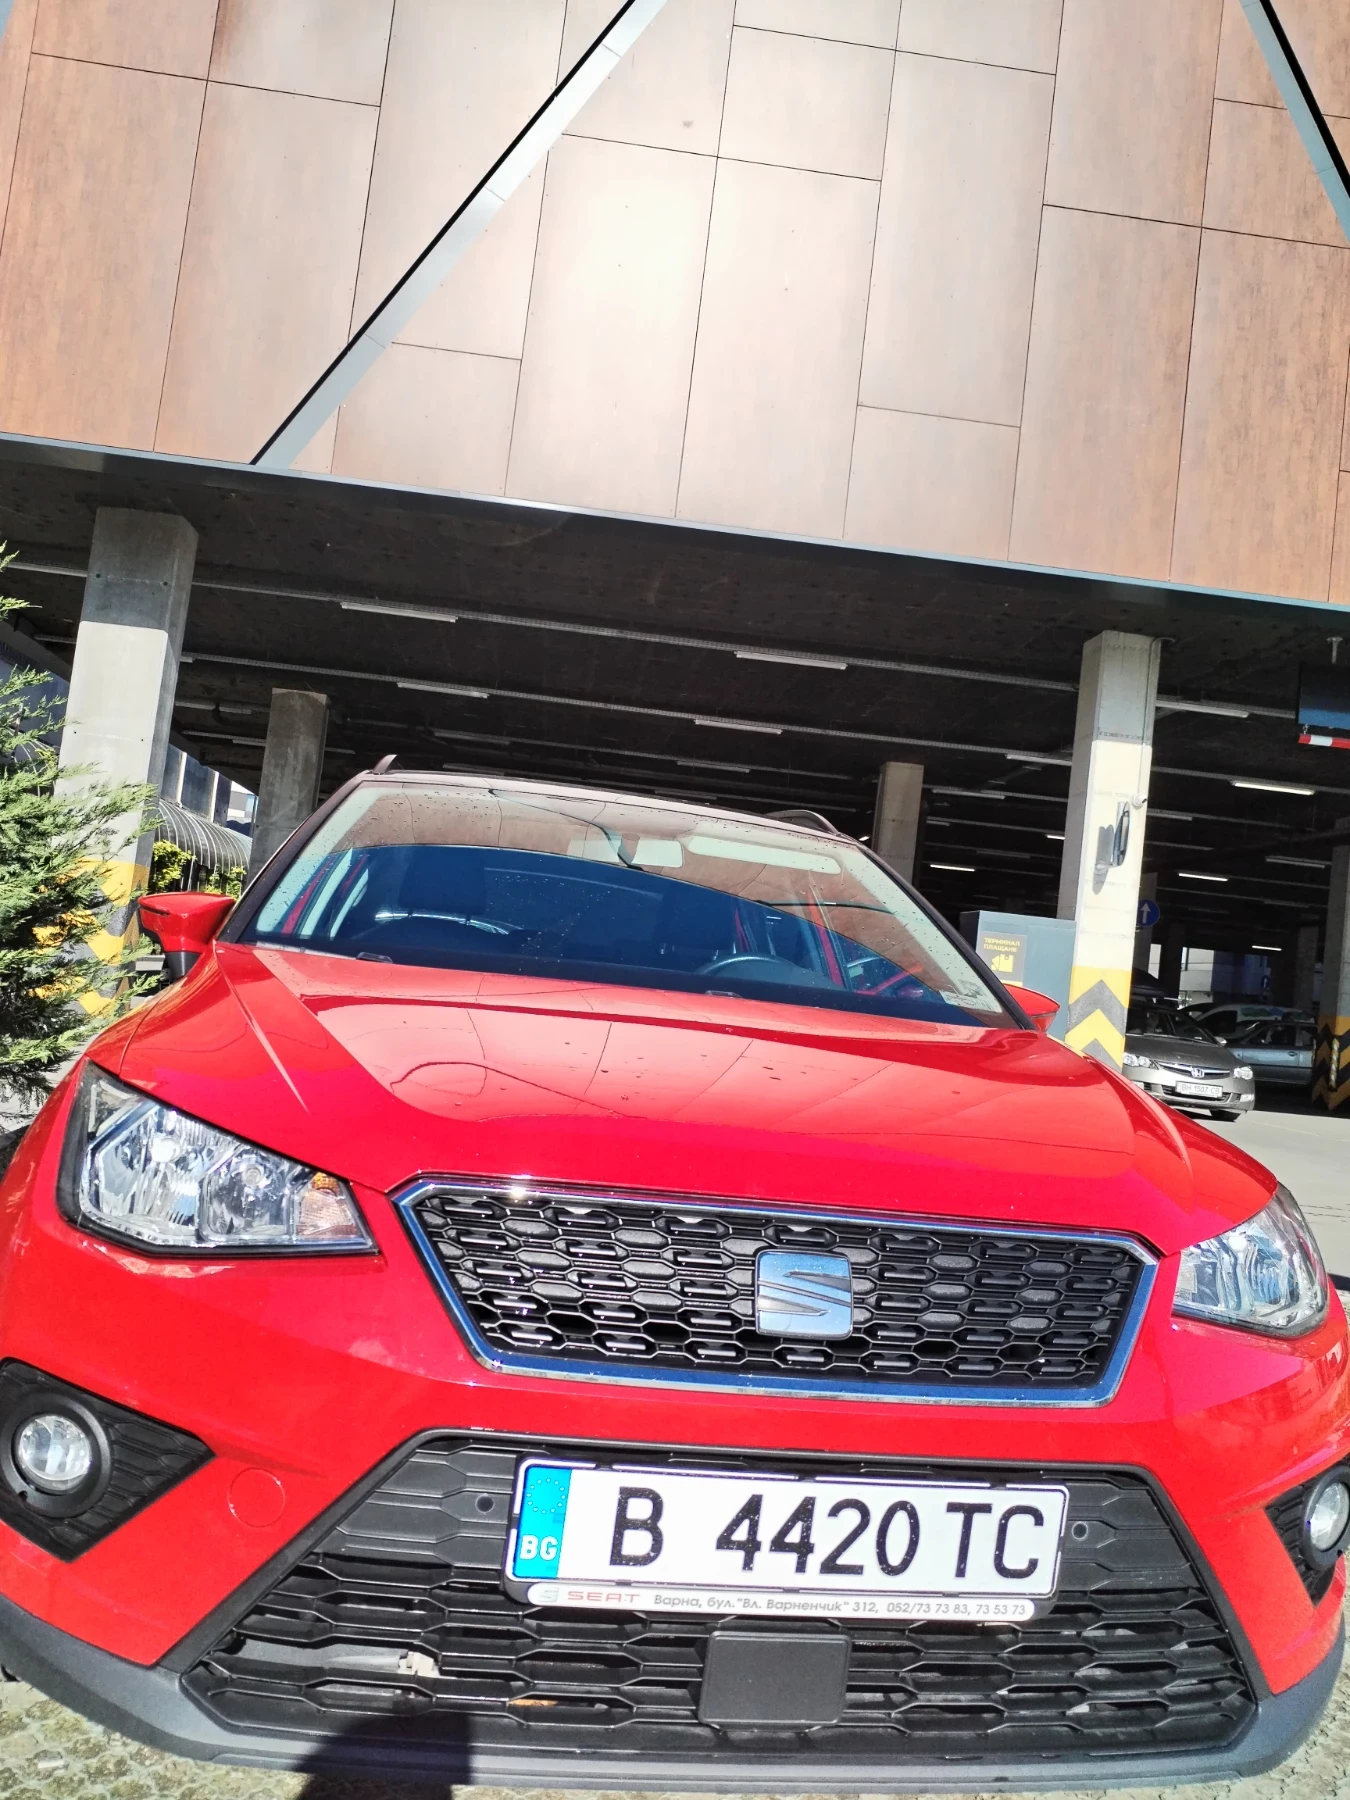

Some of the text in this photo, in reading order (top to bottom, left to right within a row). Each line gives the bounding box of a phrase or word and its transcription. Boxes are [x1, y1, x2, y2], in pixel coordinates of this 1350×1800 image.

[984, 937, 1020, 947] ТЕРМИНАЛ
[984, 944, 1017, 952] ПЛАЩАНЕ
[609, 1486, 1045, 1579] B 4420 TC
[519, 1534, 558, 1560] BG
[568, 1591, 640, 1604] SEAT
[654, 1594, 702, 1608] Варна,
[853, 1602, 878, 1613] 312,
[887, 1602, 931, 1614] 052/73
[935, 1603, 949, 1614] 73
[953, 1604, 971, 1616] 83,
[975, 1604, 990, 1616] 73
[993, 1605, 1008, 1616] 53
[1011, 1606, 1026, 1617] 73
